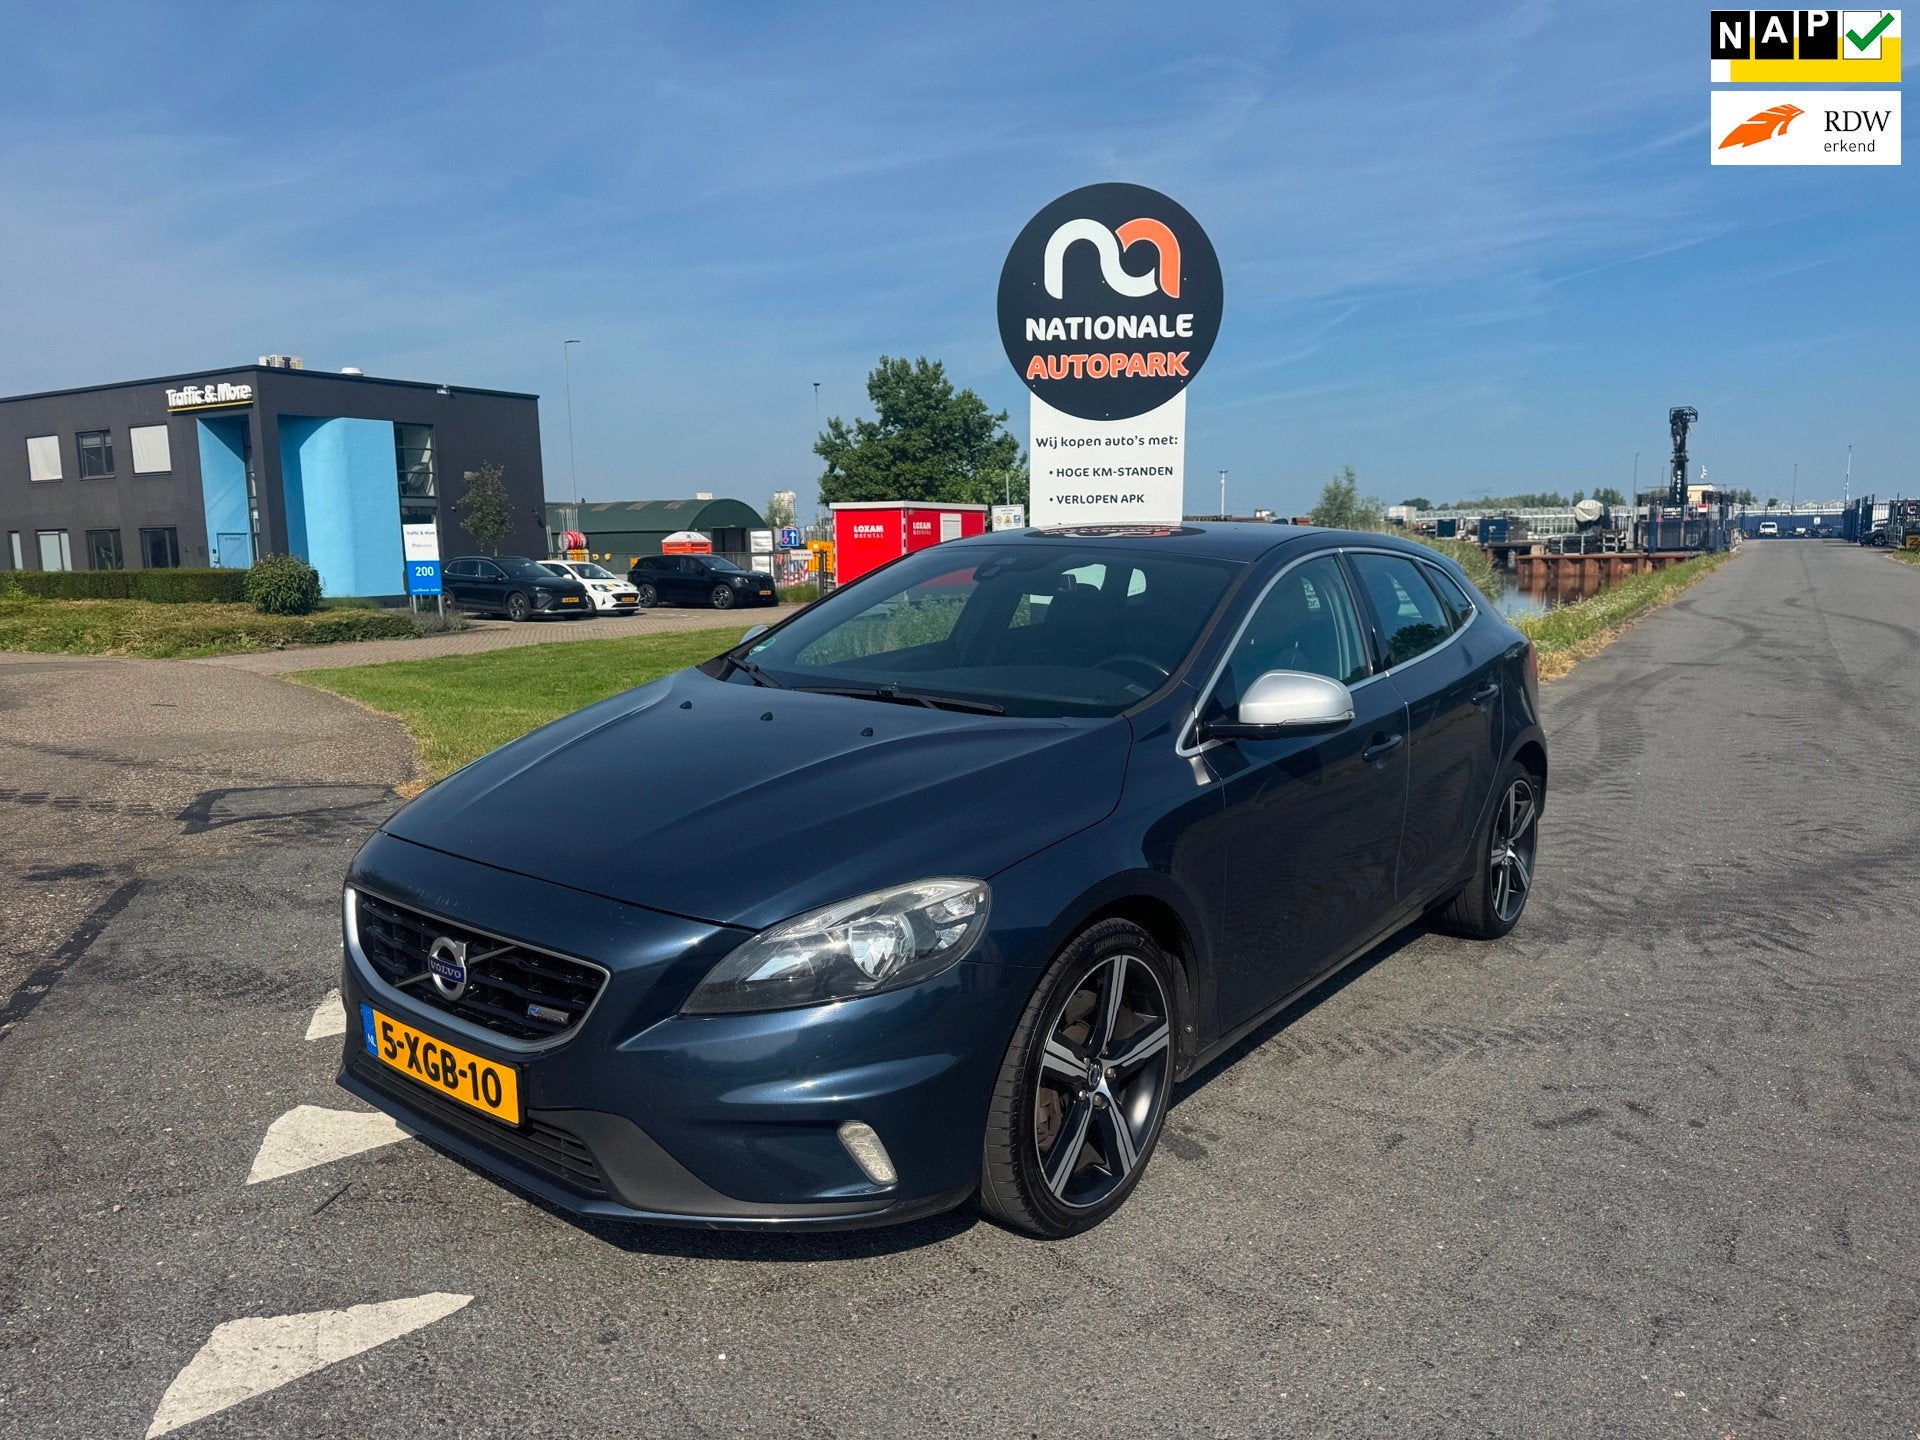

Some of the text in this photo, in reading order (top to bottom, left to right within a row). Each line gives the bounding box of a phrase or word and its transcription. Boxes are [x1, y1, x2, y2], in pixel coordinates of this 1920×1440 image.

[1025, 313, 1194, 341] NATIONALE
[1026, 351, 1190, 380] AUTOPARK
[165, 382, 253, 407] Traffic & More
[1035, 435, 1179, 450] Wij kopen auto's met:
[1056, 466, 1174, 478] HOGE KM-STANDEN
[1056, 494, 1145, 505] VERLOPEN APK
[853, 524, 884, 534] LOXAM
[912, 521, 932, 530] LOXAM
[414, 566, 435, 577] 200
[430, 960, 462, 979] VOLVO
[367, 1033, 377, 1047] NL
[381, 1020, 502, 1108] 5-XGB-10
